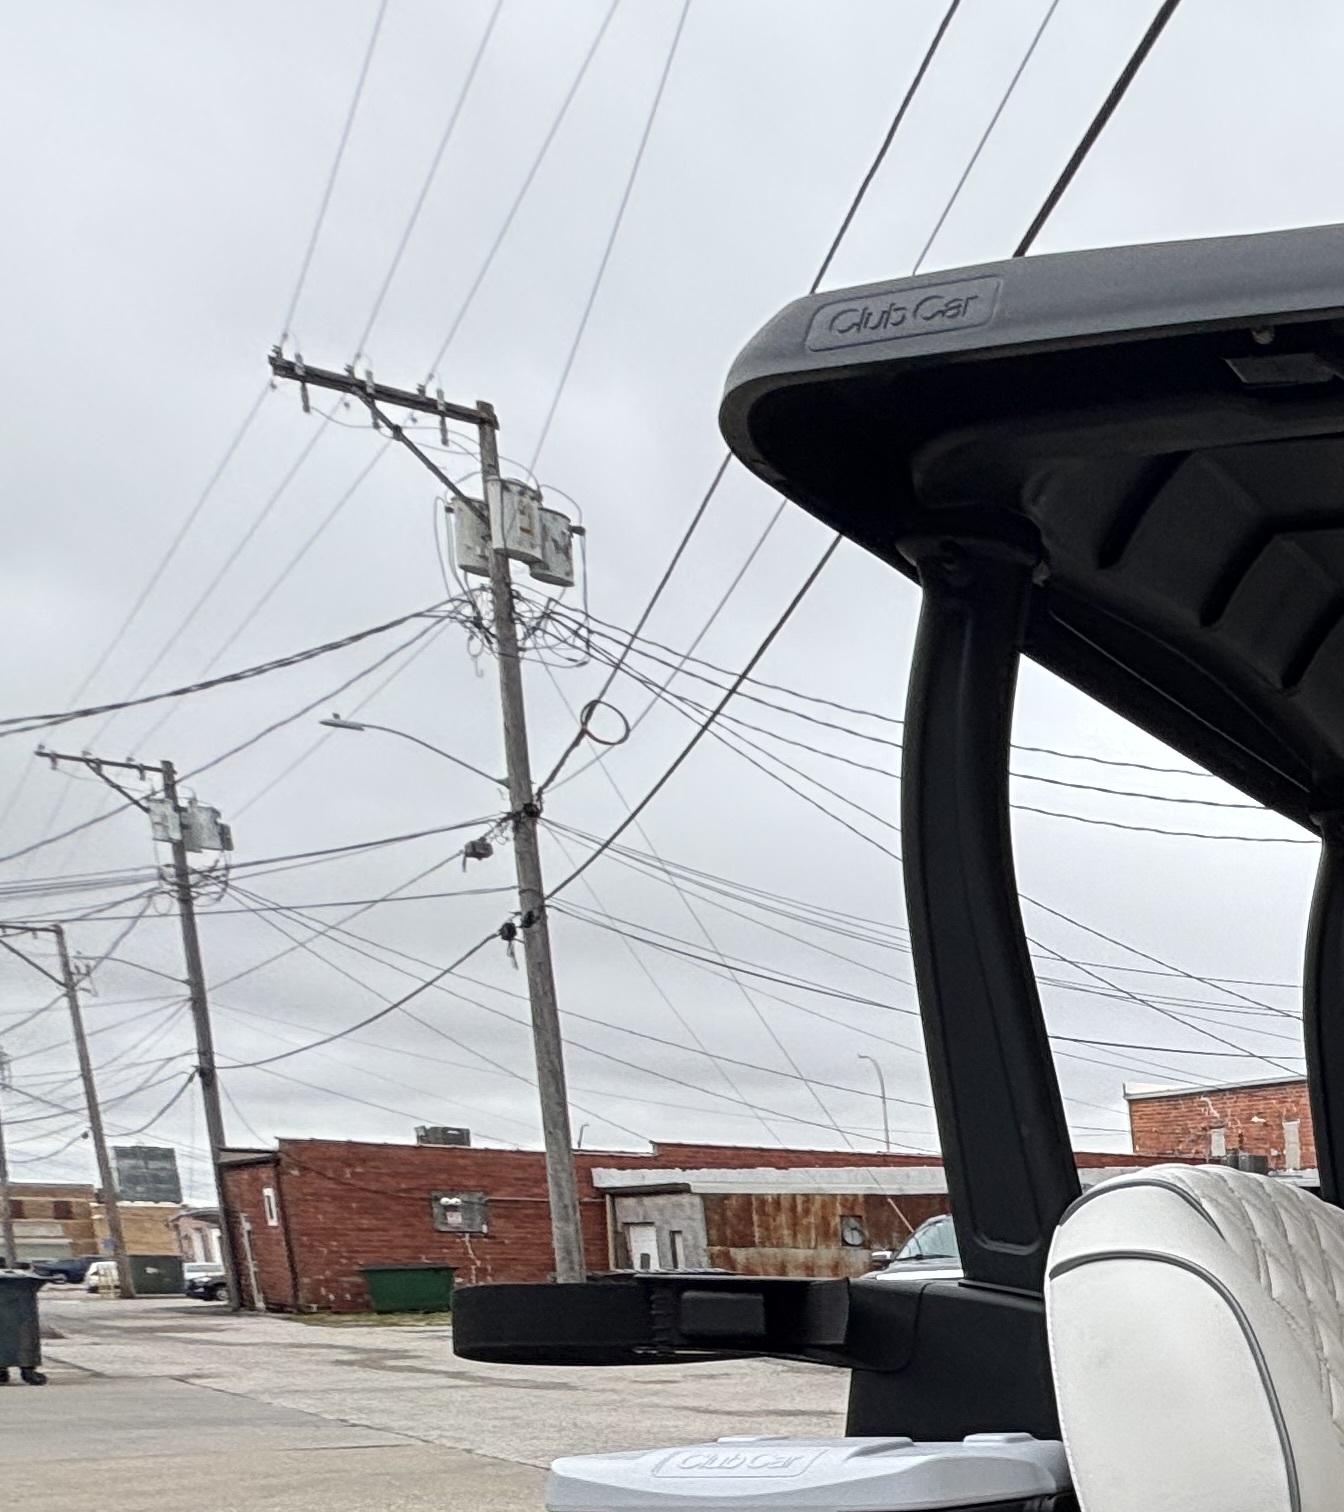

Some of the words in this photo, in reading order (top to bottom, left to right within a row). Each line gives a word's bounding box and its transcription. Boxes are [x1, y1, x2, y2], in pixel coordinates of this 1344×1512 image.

[828, 302, 907, 335] Club
[912, 295, 979, 321] Car
[676, 1452, 746, 1470] Club
[747, 1453, 804, 1470] Car
